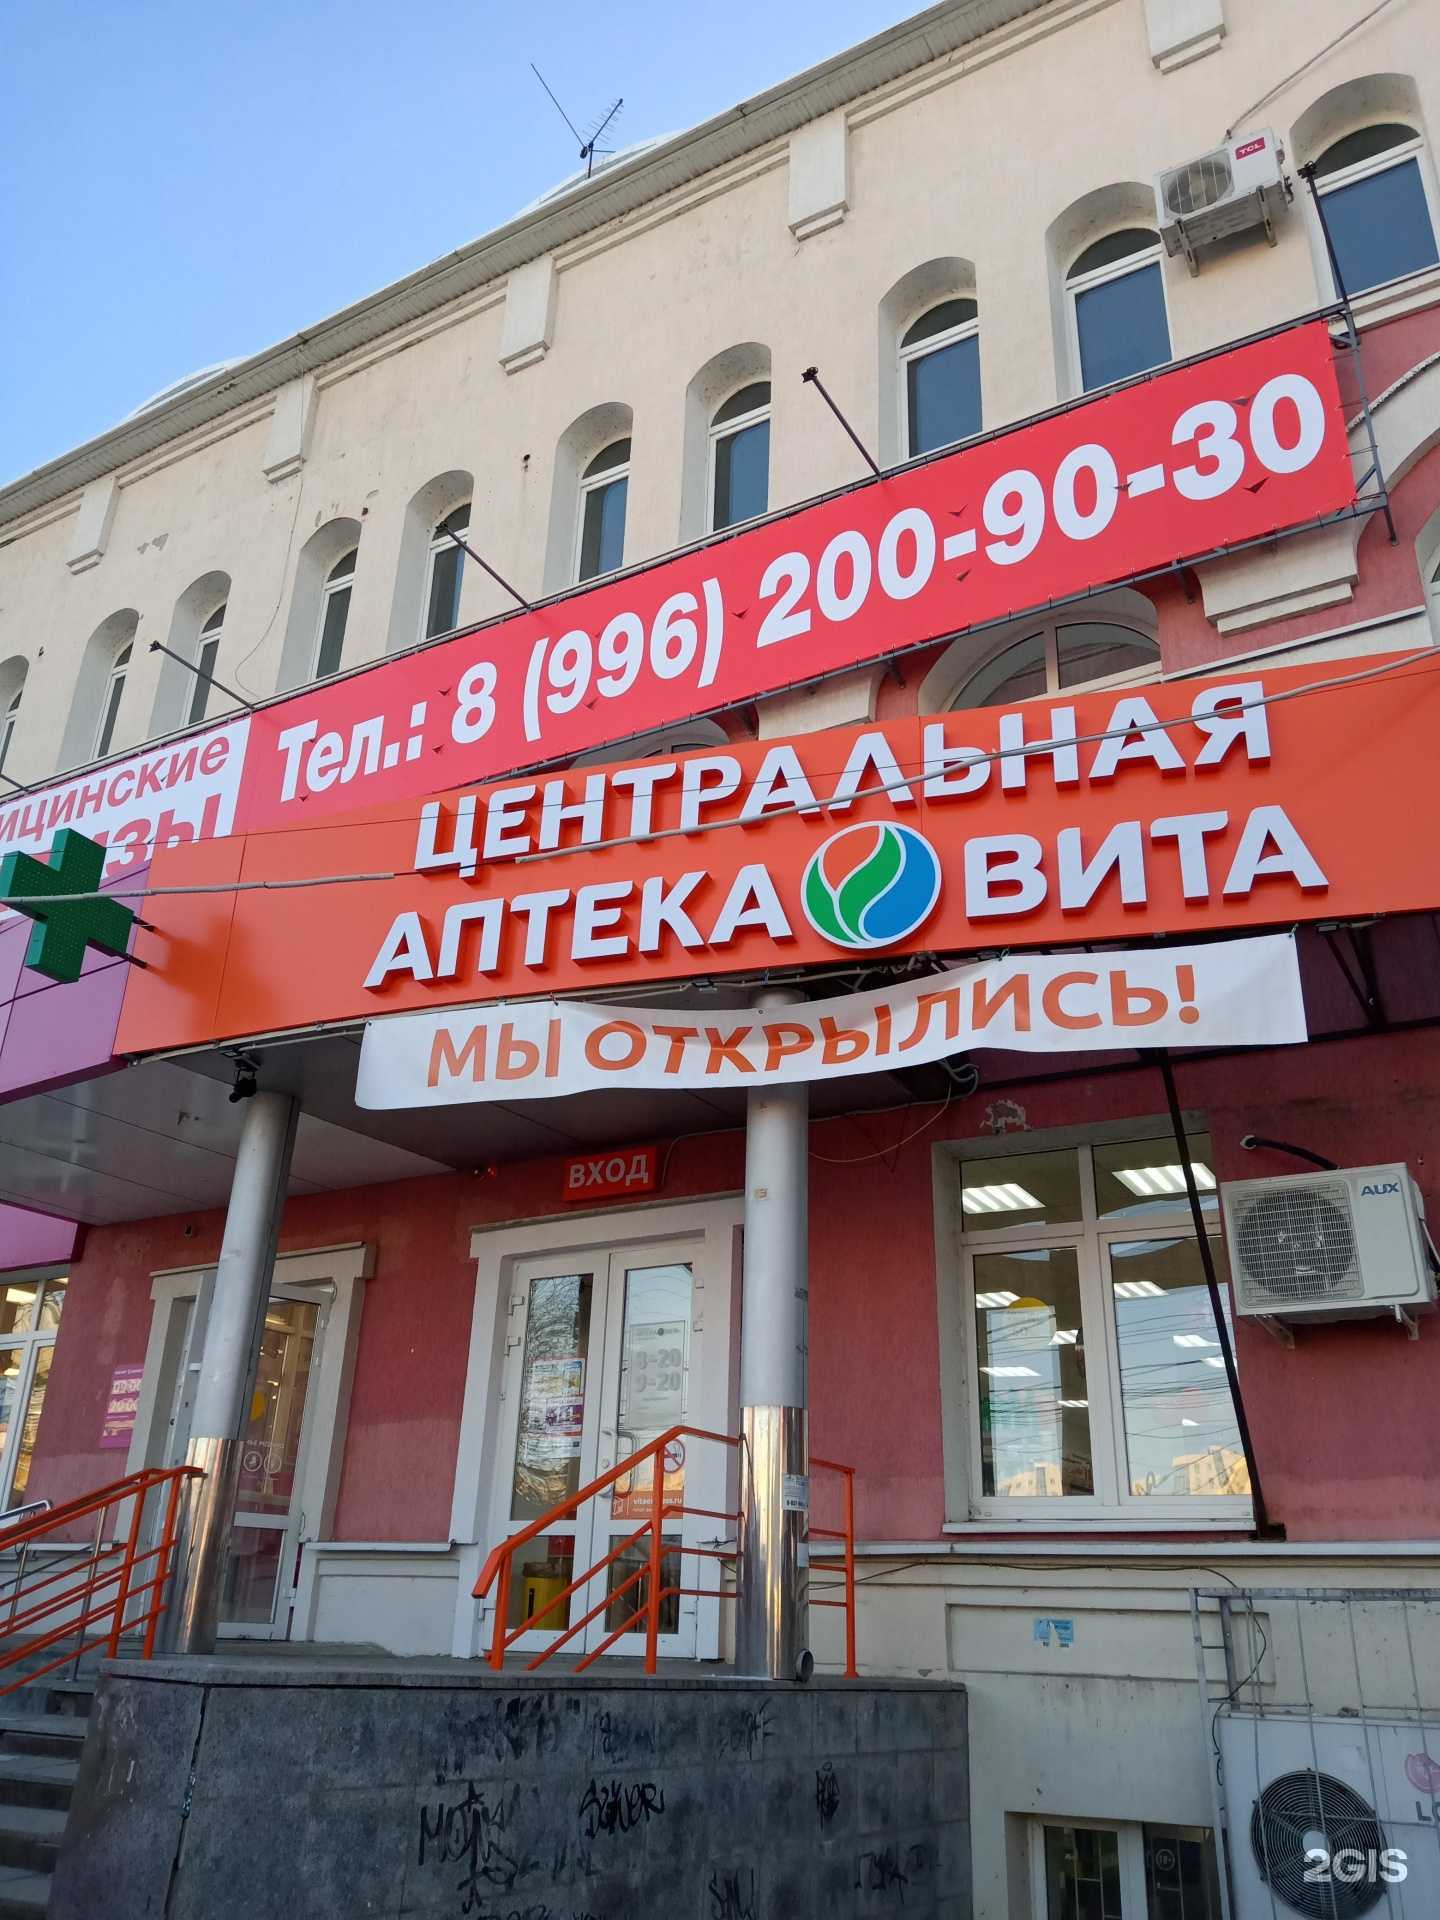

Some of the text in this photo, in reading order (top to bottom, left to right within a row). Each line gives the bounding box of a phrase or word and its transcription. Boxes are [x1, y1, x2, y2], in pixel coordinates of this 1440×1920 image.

[1239, 143, 1262, 156] TCL
[278, 373, 1325, 802] Тел.: 8 (996) 200-90-30
[414, 681, 1272, 878] ЦЕНТРАЛЬНАЯ
[362, 805, 1329, 988] АПТЕКА ВИТА
[428, 964, 1200, 1087] МЫ ОТКРЫЛИСЬ!
[568, 1154, 649, 1190] ВХОД
[1361, 1182, 1400, 1196] AUX
